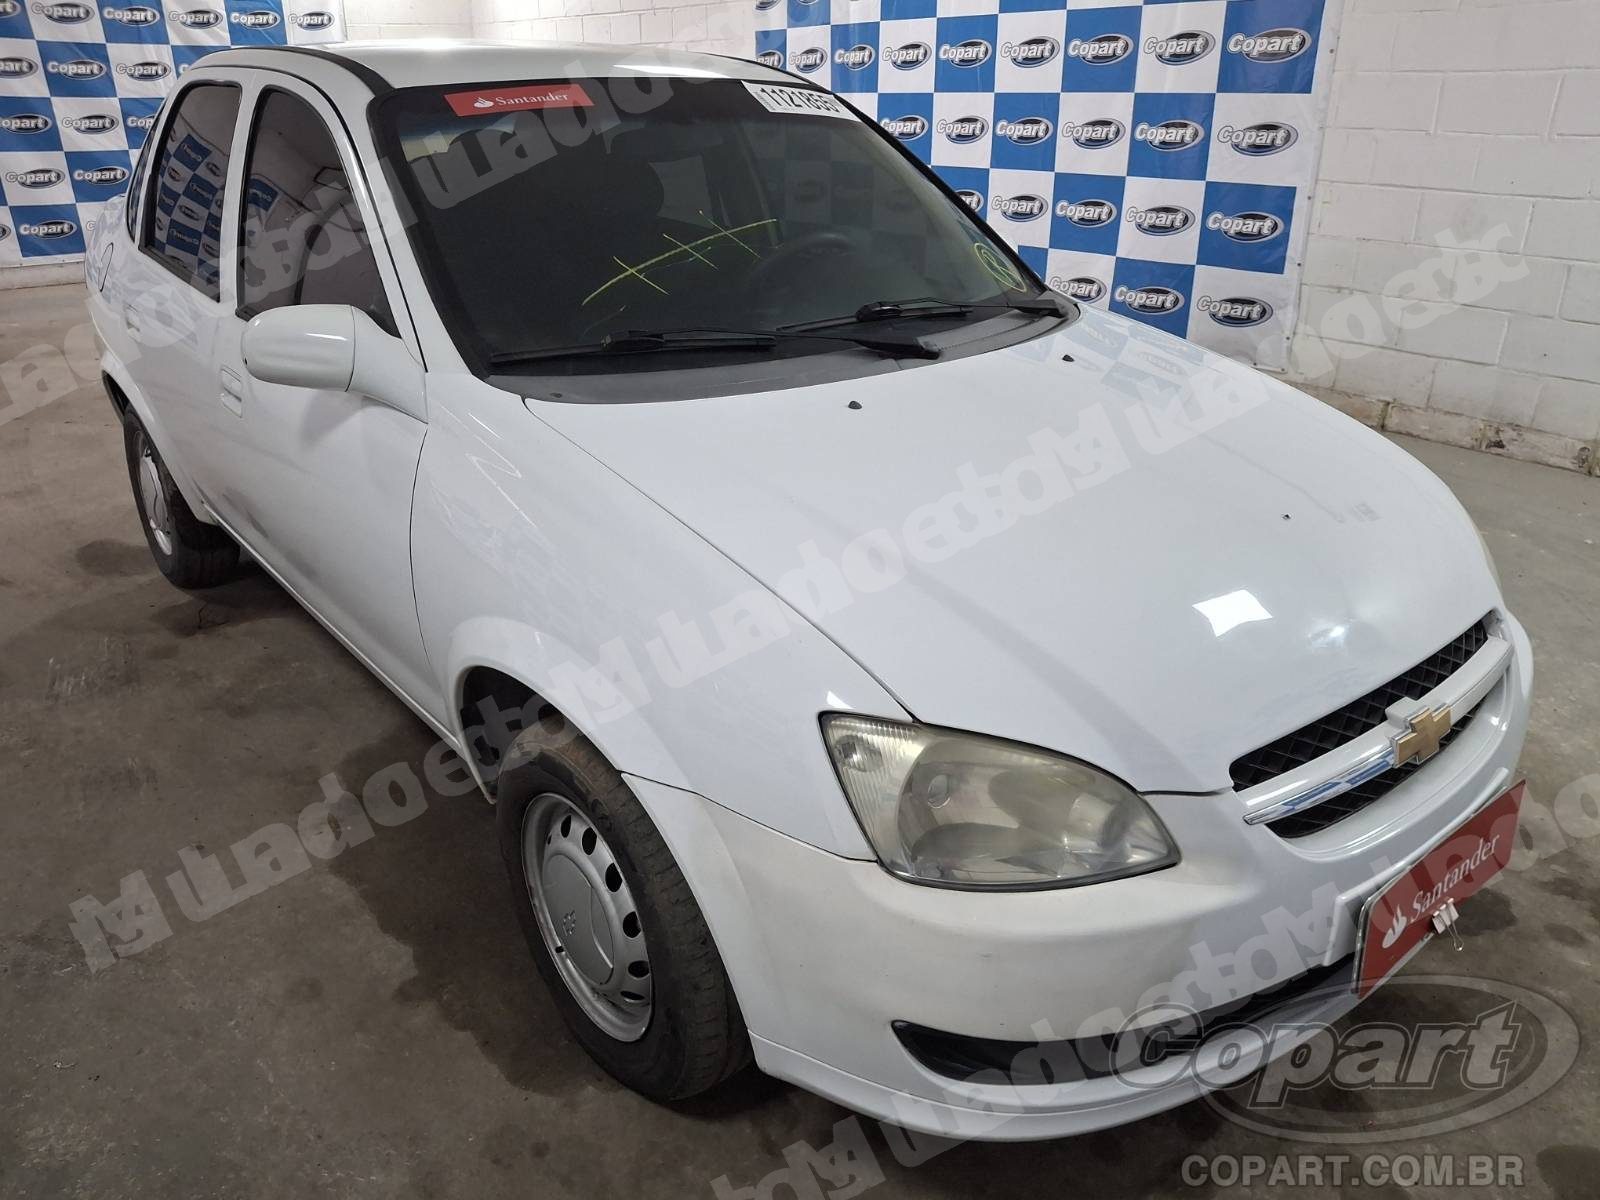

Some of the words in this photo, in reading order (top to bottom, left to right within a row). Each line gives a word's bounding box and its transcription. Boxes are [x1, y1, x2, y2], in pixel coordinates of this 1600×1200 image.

[32, 2, 87, 17] Copart
[103, 7, 153, 22] Copart
[169, 11, 215, 24] Copart
[230, 12, 274, 25] Copart
[289, 13, 329, 25] Copart
[1001, 42, 1052, 61] Copart
[1068, 39, 1124, 58] Copart
[1144, 37, 1202, 57] Copart
[1227, 32, 1301, 55] Copart
[789, 50, 821, 67] Copart
[834, 48, 870, 66] Copart
[882, 47, 925, 65] Copart
[939, 44, 985, 63] Copart
[47, 61, 100, 75] Copart
[116, 63, 164, 76] Copart
[496, 92, 568, 105] Santander
[760, 87, 840, 113] 1121855
[0, 117, 44, 130] opart
[62, 117, 111, 129] Copart
[127, 117, 152, 130] Cop
[880, 117, 922, 135] Copart
[937, 119, 982, 138] Copart
[995, 120, 1045, 139] Copart
[1062, 122, 1116, 142] Copart
[1135, 122, 1194, 144] Copart
[1217, 125, 1286, 147] Copart
[5, 171, 57, 184] Copart
[73, 169, 122, 182] Copart
[992, 196, 1040, 214] Copart
[1055, 200, 1109, 221] Copart
[1126, 206, 1185, 228] Copart
[1206, 212, 1273, 236] Copart
[20, 223, 70, 235] Copart
[1050, 276, 1099, 297] Copart
[1115, 286, 1176, 309] Copart
[1197, 296, 1261, 320] Copart
[1411, 834, 1500, 919] Santander
